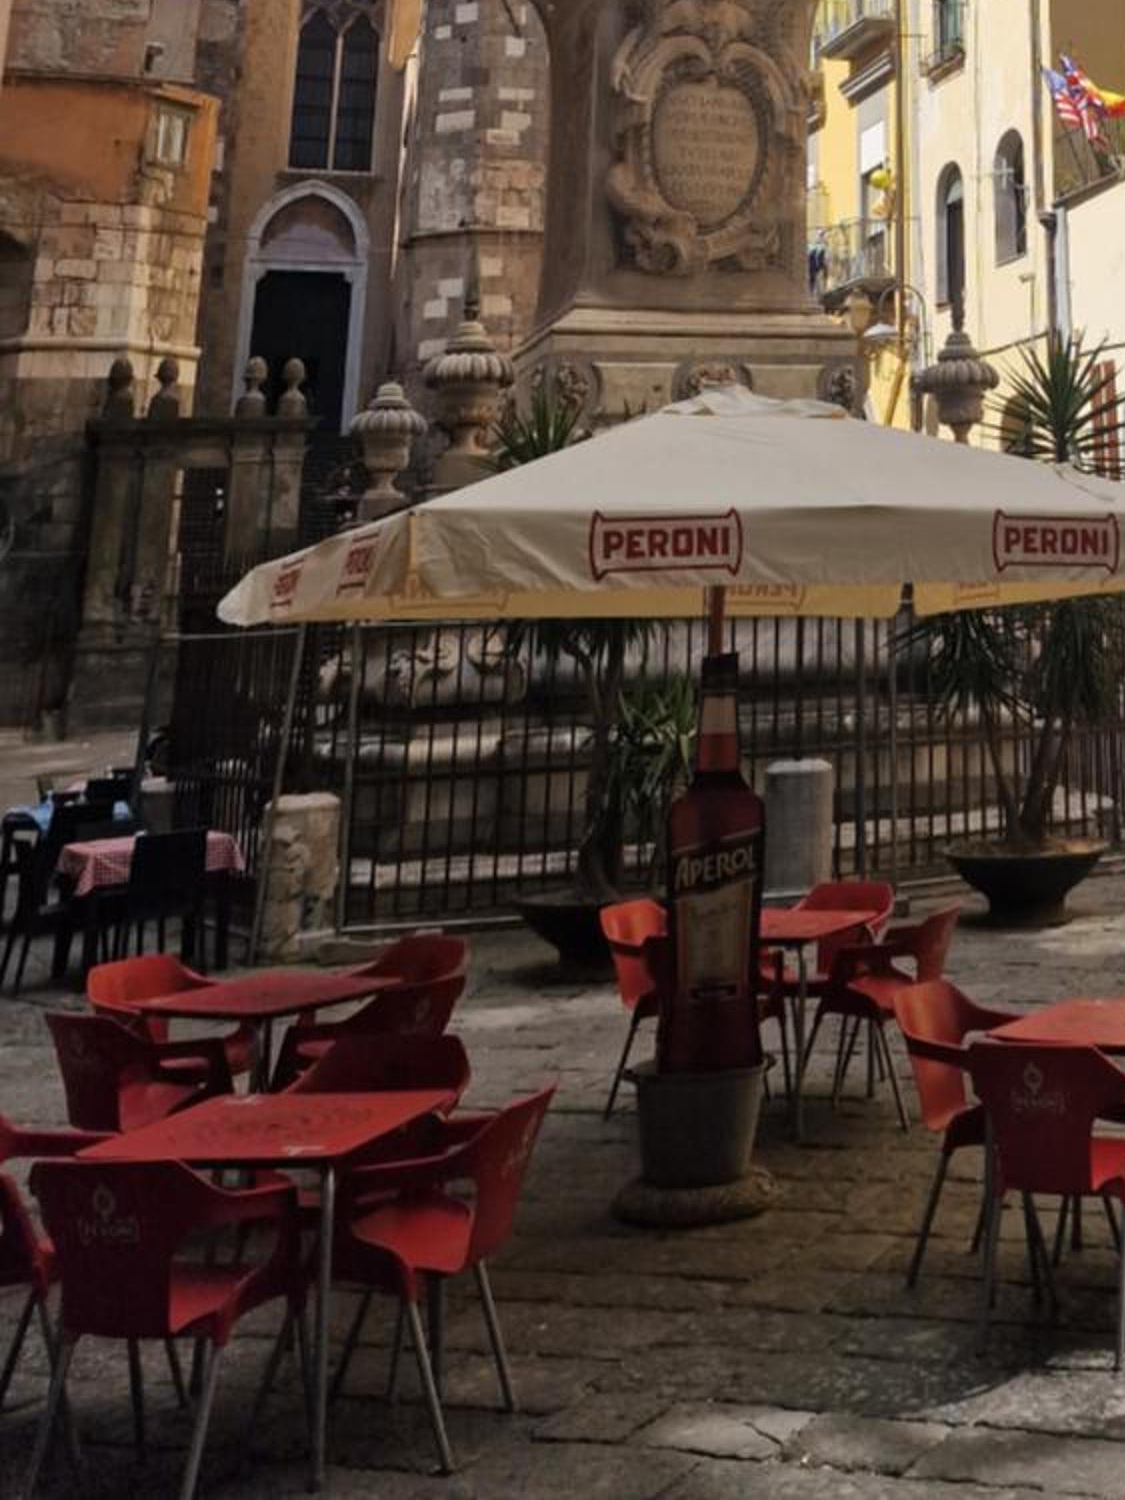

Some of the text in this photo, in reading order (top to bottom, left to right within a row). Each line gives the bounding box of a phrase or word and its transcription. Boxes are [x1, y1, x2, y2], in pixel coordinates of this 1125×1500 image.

[603, 526, 730, 559] PERONI
[1004, 527, 1108, 555] PERONI
[674, 845, 756, 891] APEROL
